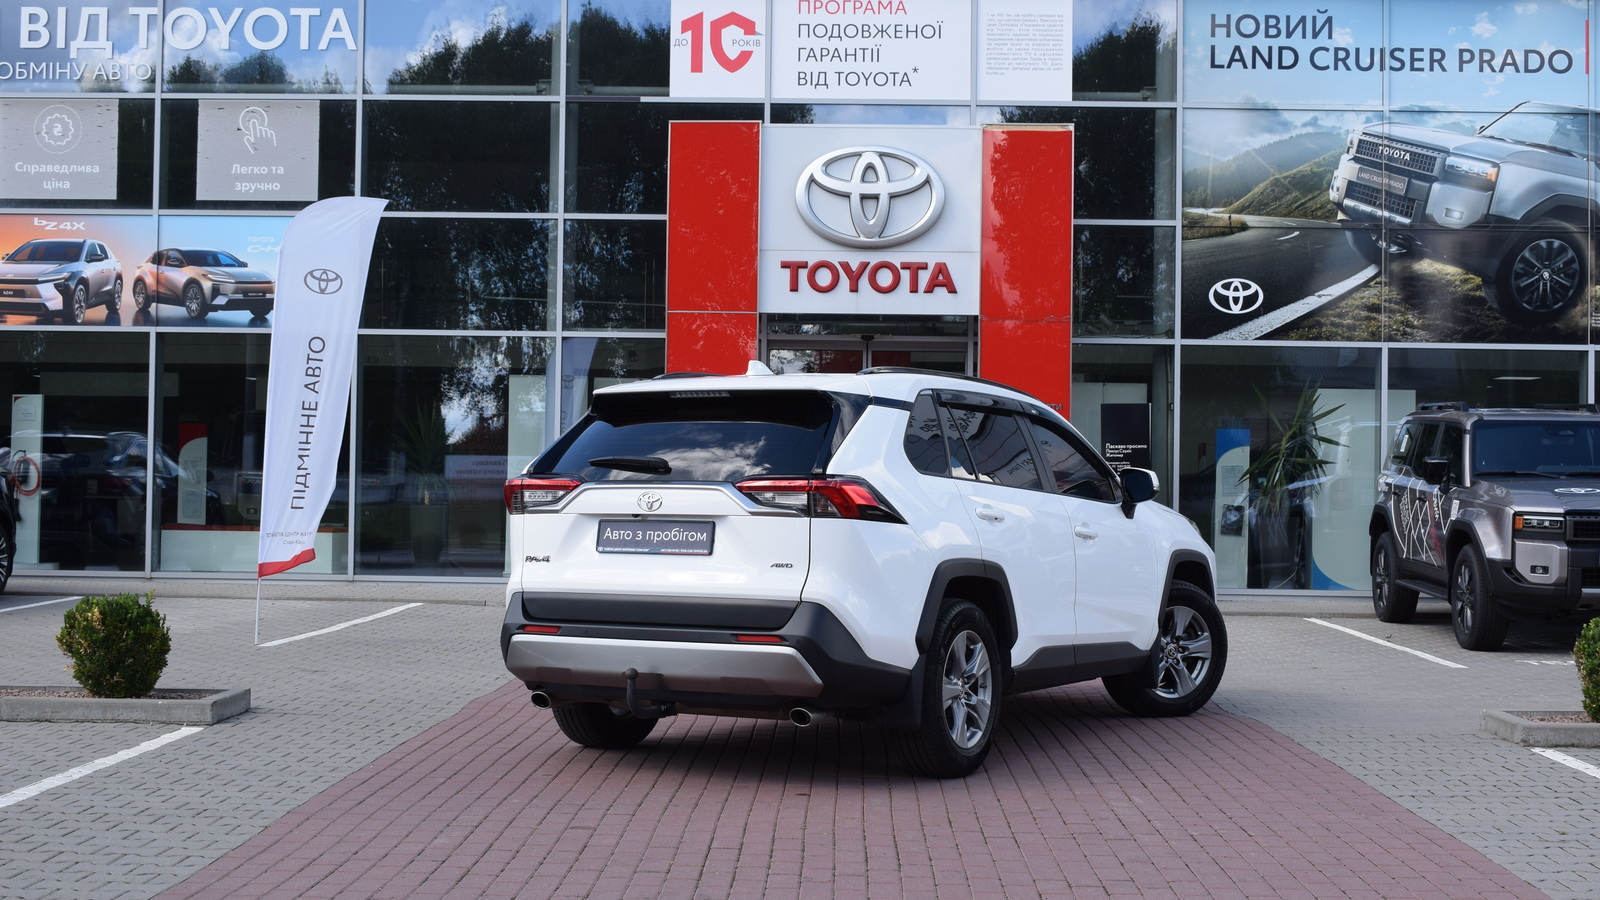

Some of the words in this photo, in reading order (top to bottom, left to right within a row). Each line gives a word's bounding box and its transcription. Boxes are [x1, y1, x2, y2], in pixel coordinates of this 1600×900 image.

[798, 0, 908, 15] ПРОГРАМА
[20, 6, 113, 59] ВІД
[128, 6, 357, 50] TOYOTA
[798, 20, 944, 42] ПОДОВЖЕНОЇ
[1210, 8, 1334, 40] НОВИЙ
[673, 38, 688, 48] ДО
[732, 38, 761, 48] РОКІВ
[797, 44, 881, 62] ГАРАНТІЇ
[1210, 44, 1300, 70] LAND
[1309, 46, 1446, 72] CRUISER
[1458, 48, 1574, 74] PRADO
[0, 62, 88, 80] ОБМІНУ
[92, 62, 152, 80] АВТО
[797, 71, 829, 90] ВІД
[1378, 146, 1410, 161] TOYOTA
[14, 162, 100, 174] Справедлива
[230, 164, 268, 176] Легко
[270, 166, 284, 176] та
[1358, 172, 1370, 180] LAND
[42, 177, 70, 190] ціна
[234, 181, 281, 193] зручно
[780, 260, 958, 295] TOYOTA
[304, 336, 326, 394] АВТО
[290, 400, 319, 510] ПІДМІННЕ
[603, 527, 632, 540] Авто
[635, 532, 642, 540] з
[646, 528, 707, 544] пробігом
[525, 555, 551, 563] RAV4
